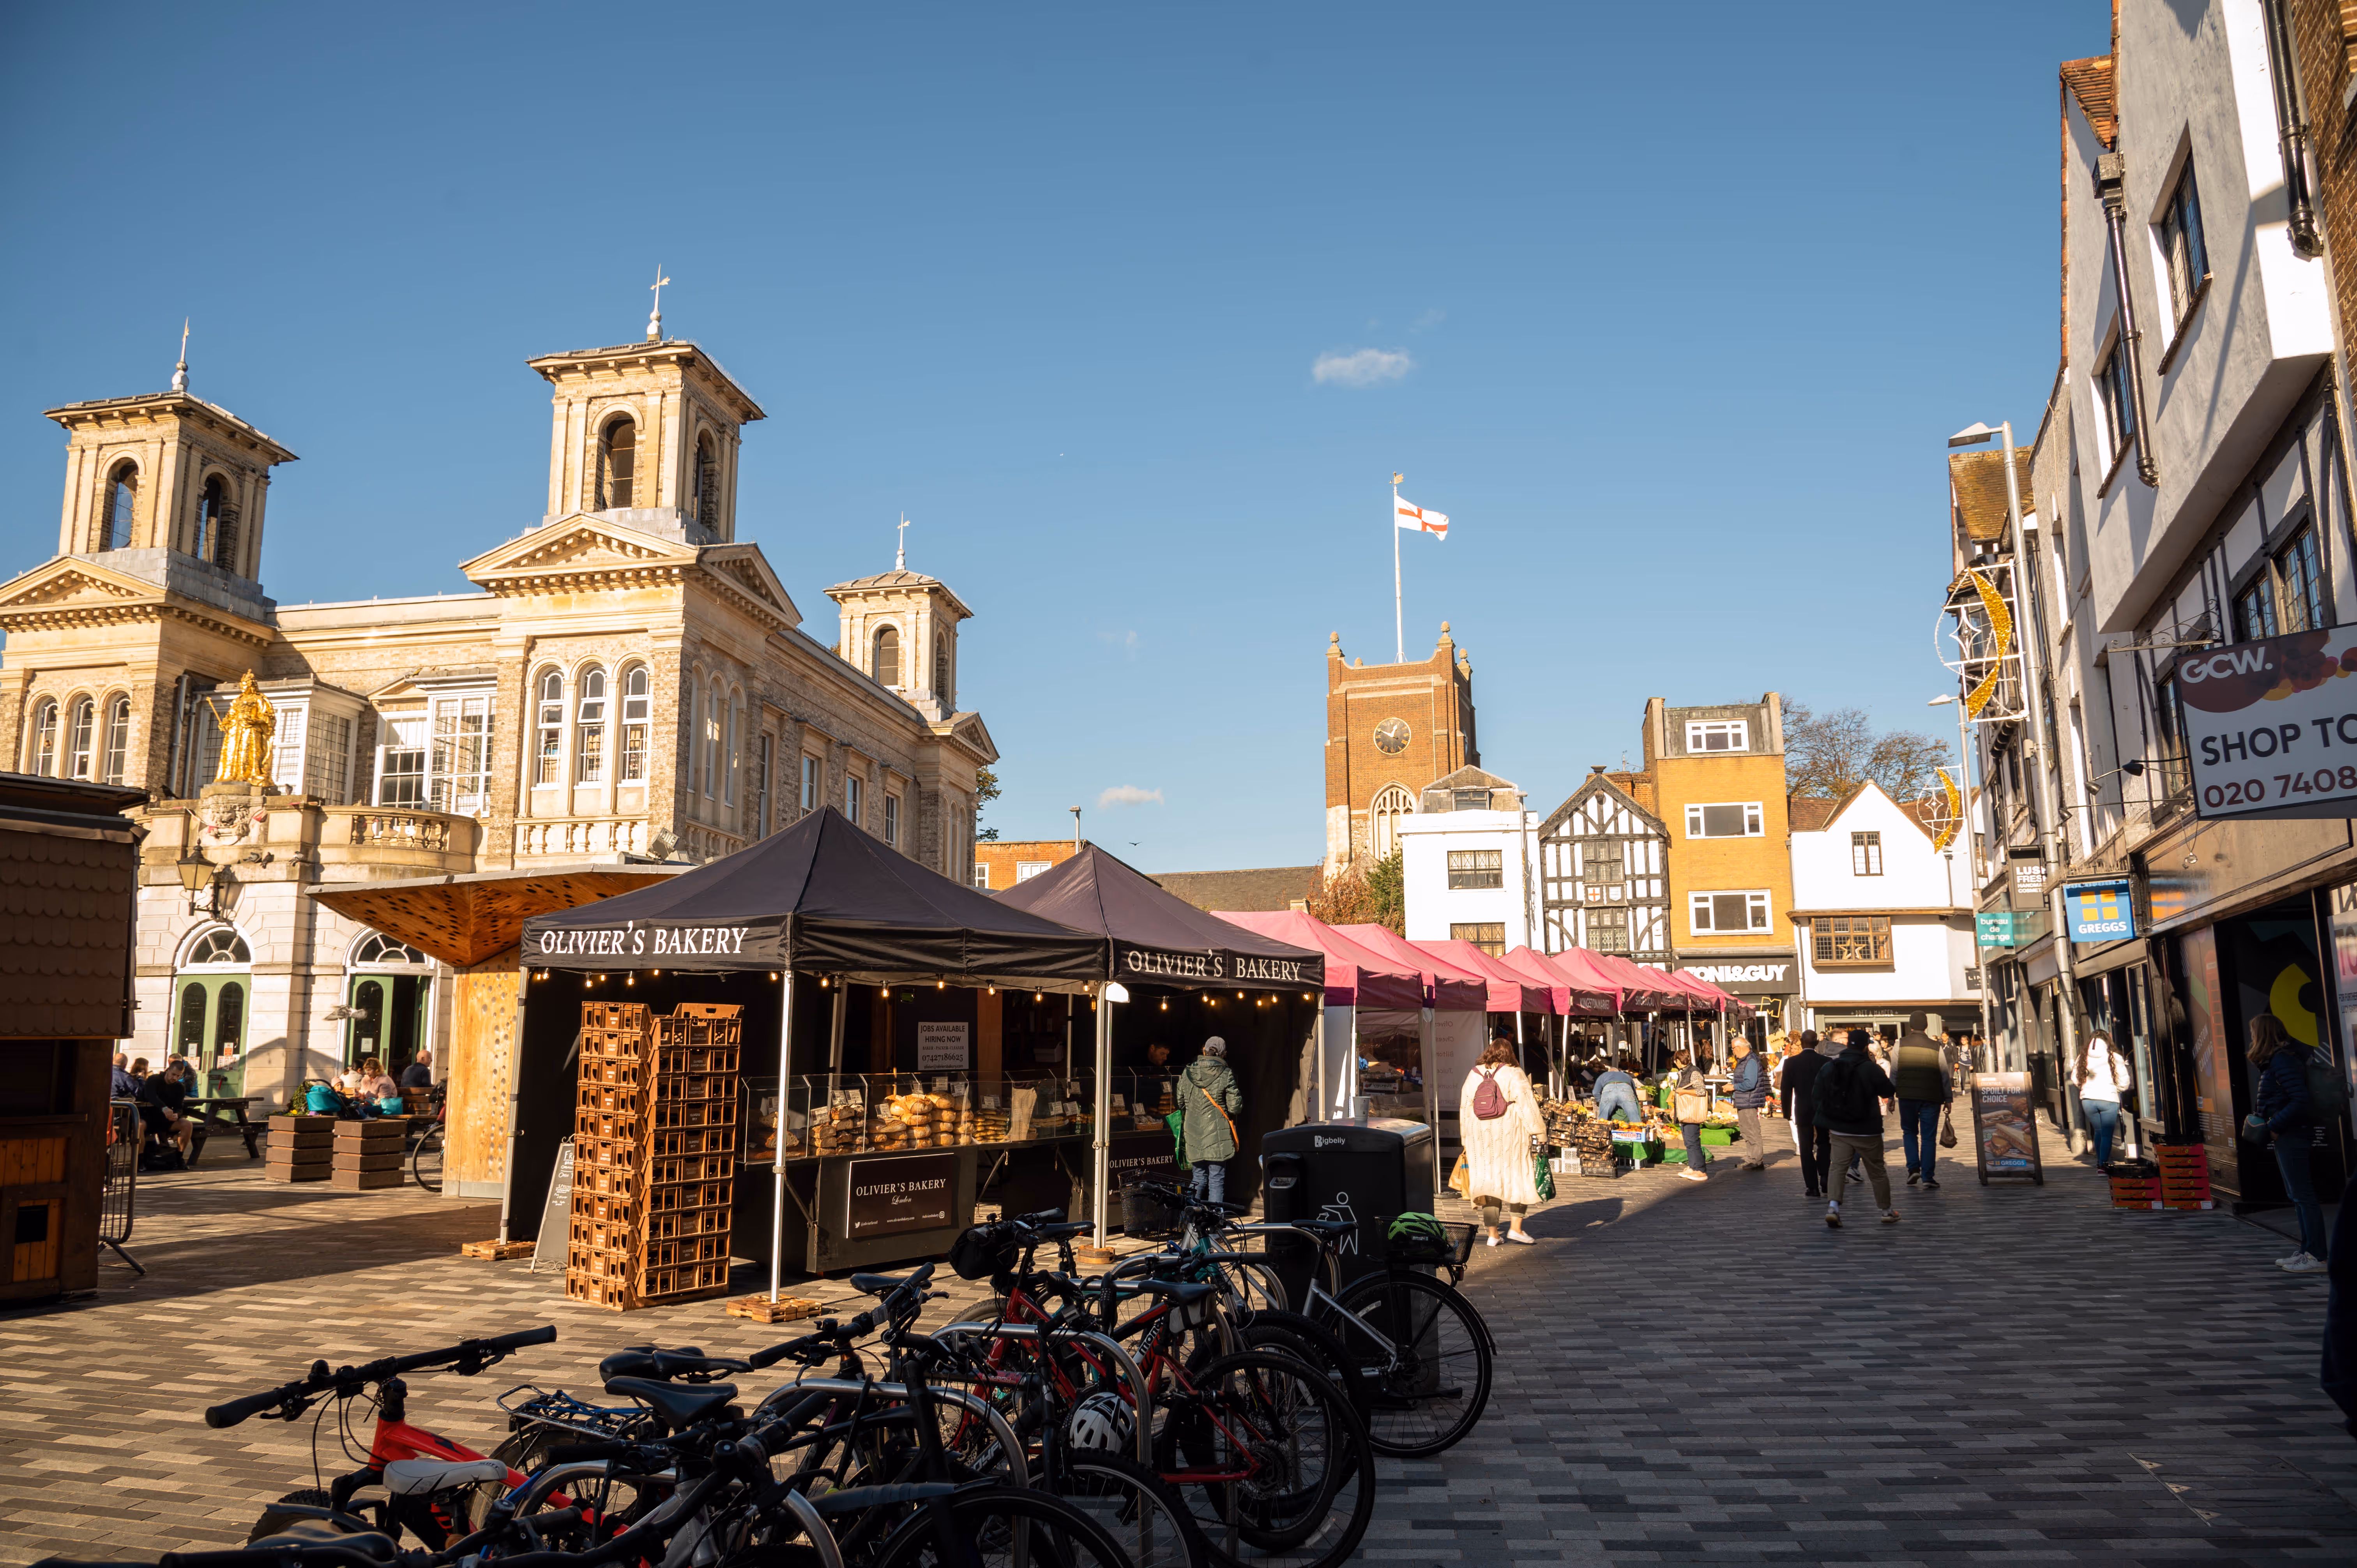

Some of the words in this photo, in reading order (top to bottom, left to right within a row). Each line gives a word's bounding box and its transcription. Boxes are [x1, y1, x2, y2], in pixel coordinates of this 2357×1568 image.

[2180, 646, 2273, 683] GCW.
[2200, 723, 2301, 766] SHOP
[2204, 779, 2265, 808] 020
[2273, 766, 2357, 798] 7408
[2078, 922, 2127, 934] GREGGS
[540, 920, 645, 955] OLIVIER'S
[653, 927, 749, 954] BAKERY
[1980, 933, 2010, 941] change
[1128, 949, 1223, 977] OLIVIER'S
[1236, 957, 1301, 981] BAKERY
[922, 1053, 963, 1062] 07427186625
[1315, 1135, 1346, 1147] Bigbelly
[1110, 1158, 1145, 1168] OLIVIER'S
[1147, 1155, 1173, 1165] BAKERY
[856, 1183, 905, 1196] OLIVIER'S
[908, 1179, 946, 1191] BAKERY
[891, 1195, 912, 1204] London
